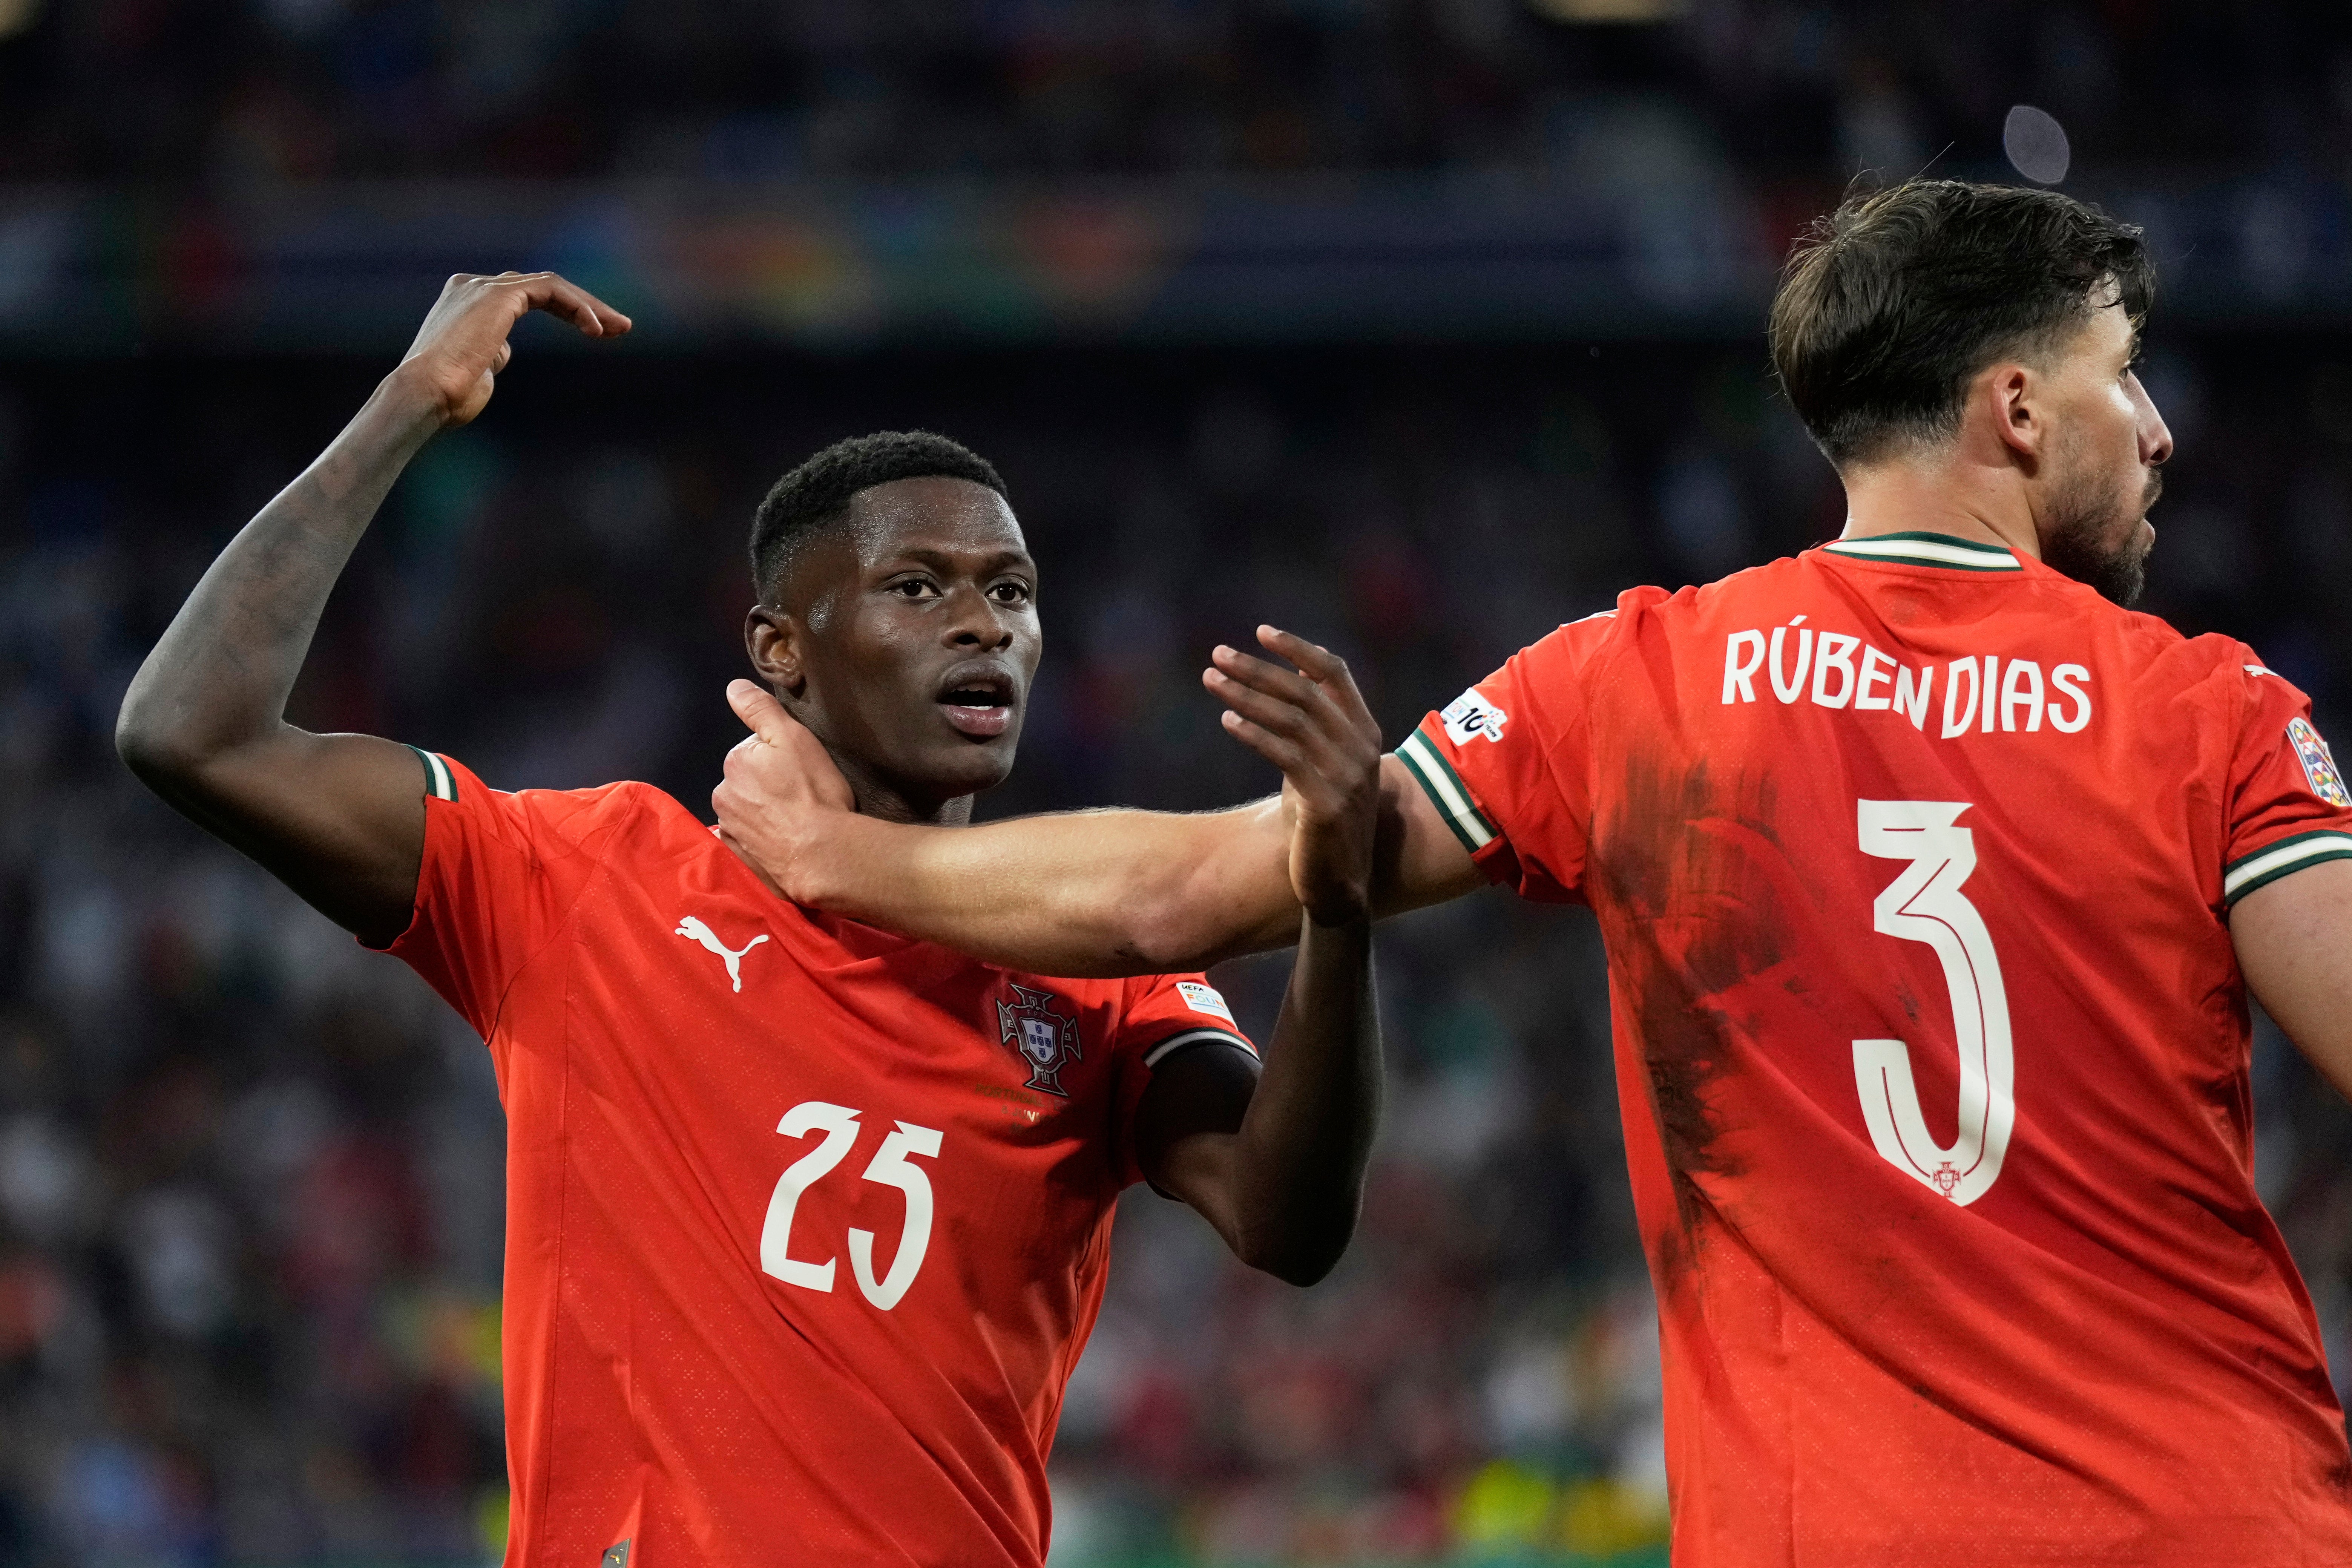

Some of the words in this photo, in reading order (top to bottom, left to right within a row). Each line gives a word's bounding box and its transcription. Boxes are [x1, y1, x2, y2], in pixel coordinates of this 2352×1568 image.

[1457, 707, 1484, 732] 10
[1722, 615, 1933, 731] RÚBEN
[1941, 655, 2092, 739] DIAS
[1852, 798, 2016, 1207] 3
[975, 1083, 1044, 1107] PORTUGAL
[760, 1101, 944, 1311] 25
